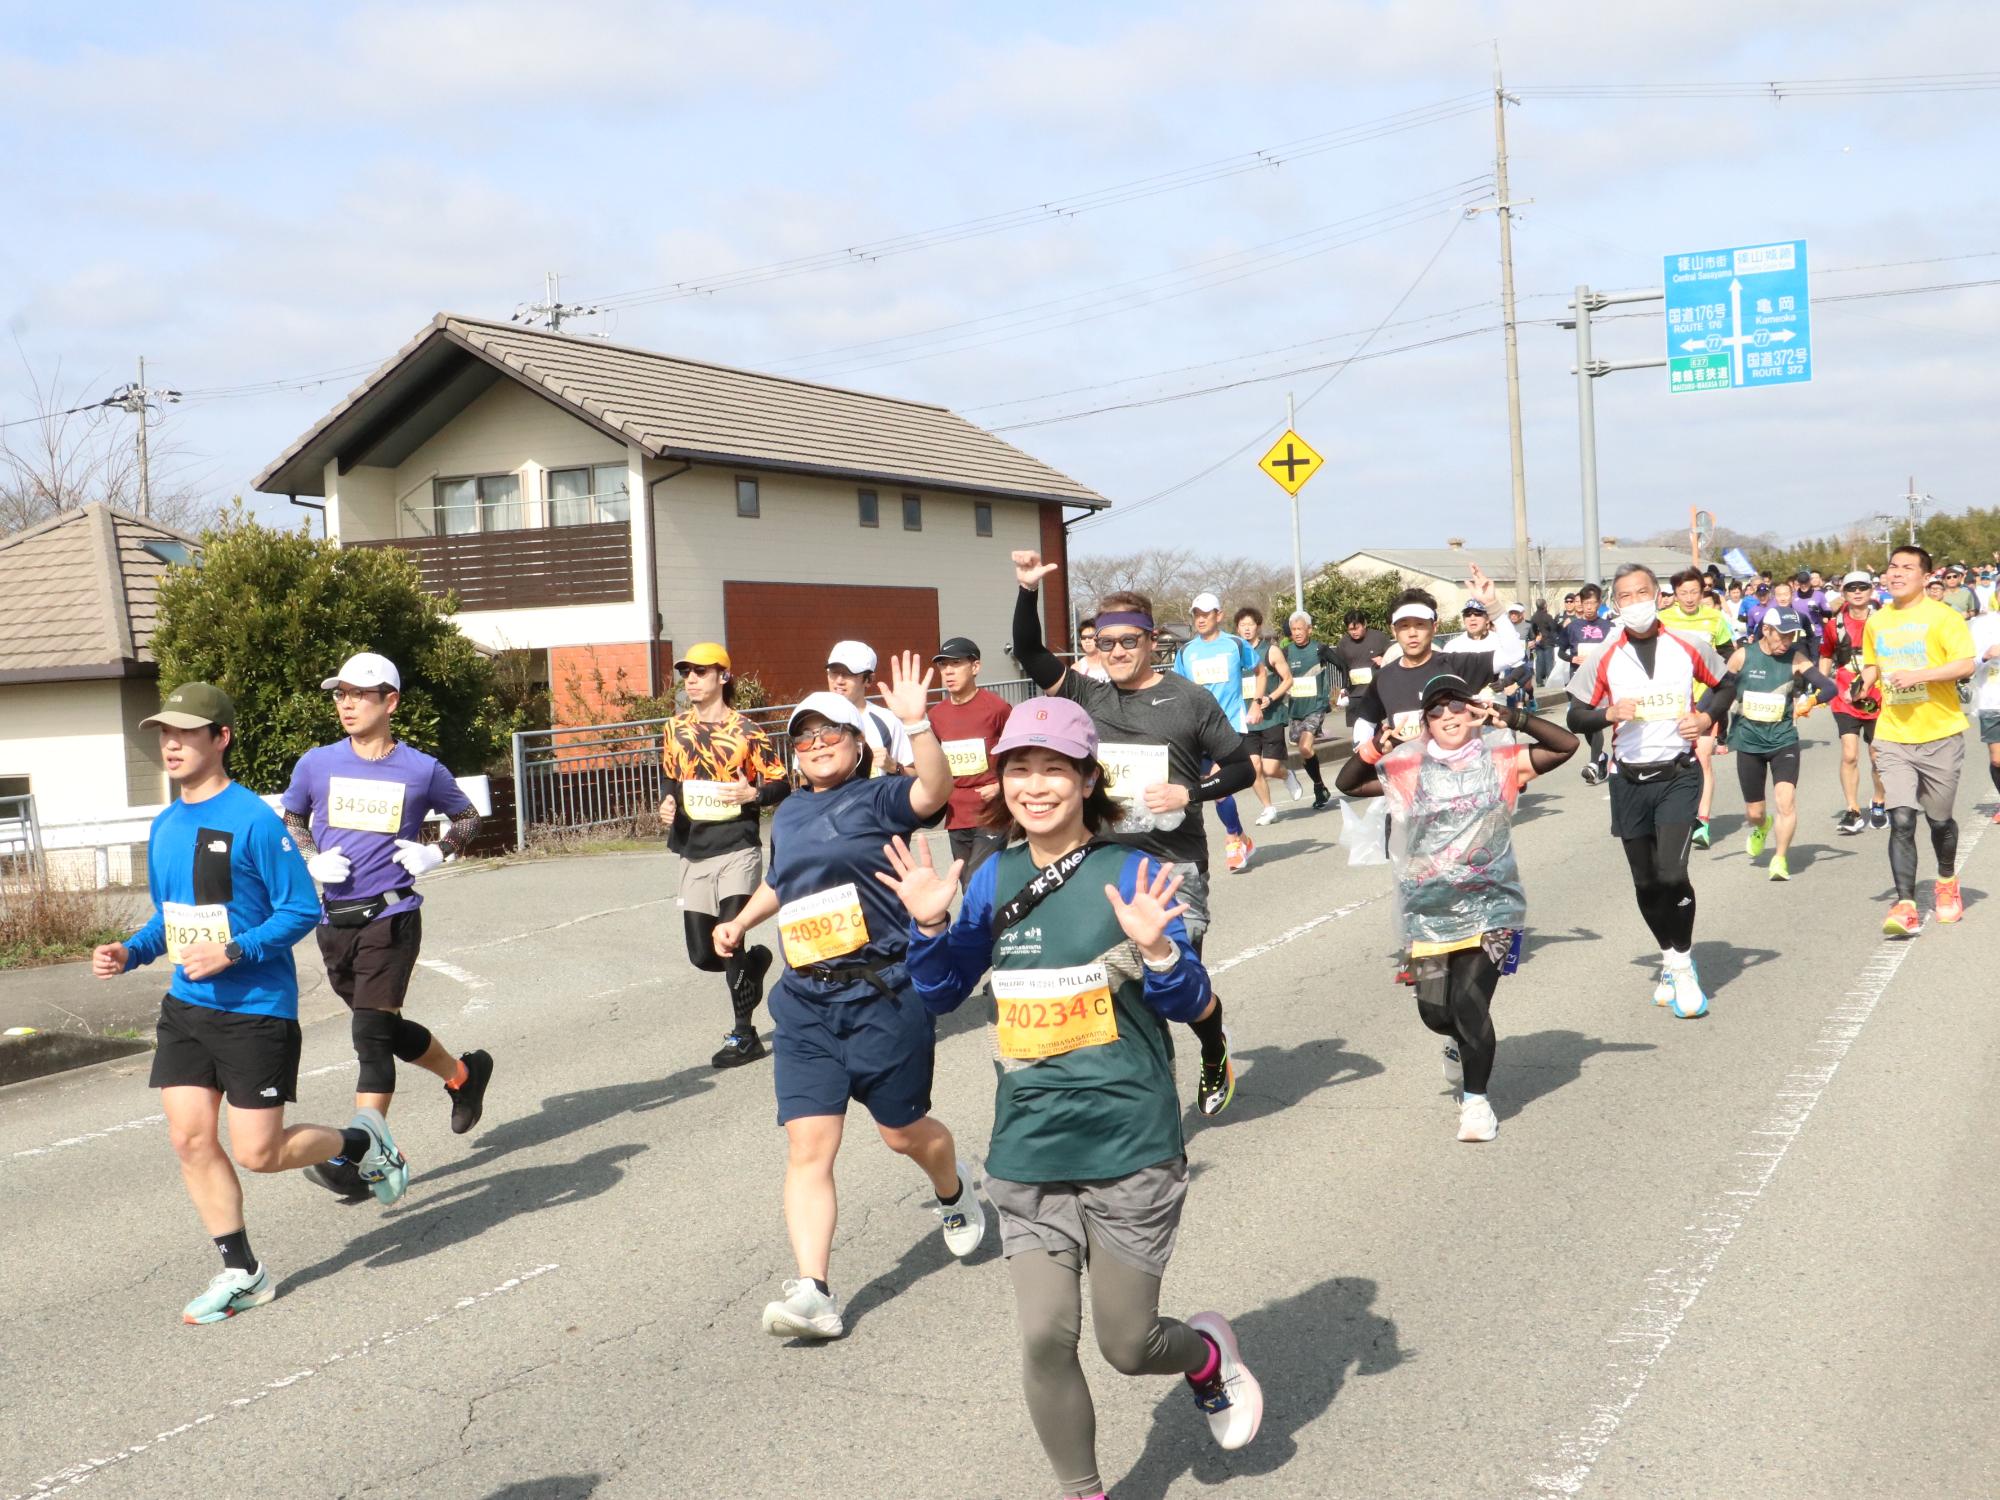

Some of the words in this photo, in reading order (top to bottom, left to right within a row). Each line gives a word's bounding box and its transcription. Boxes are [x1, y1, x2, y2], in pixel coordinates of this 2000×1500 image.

[1756, 296, 1794, 313] 亀岡
[1669, 304, 1727, 324] 国道176号
[1756, 314, 1796, 324] Kameoka
[1674, 323, 1703, 333] ROUTE
[1708, 320, 1722, 330] 176
[1708, 337, 1719, 347] 77
[1755, 333, 1767, 343] 77
[1747, 348, 1808, 368] 国道372号
[1753, 367, 1783, 378] ROUTE
[1787, 365, 1804, 375] 372
[945, 752, 977, 765] 3939
[334, 796, 388, 815] 34568
[391, 805, 399, 817] C
[822, 890, 852, 905] PILLAR
[194, 910, 223, 919] PILLAR
[167, 923, 212, 945] 31823
[217, 931, 227, 944] B
[789, 912, 848, 943] 40392
[850, 913, 862, 928] C
[1059, 972, 1102, 987] PILLAR
[1005, 994, 1089, 1029] 40234
[1094, 998, 1108, 1016] C
